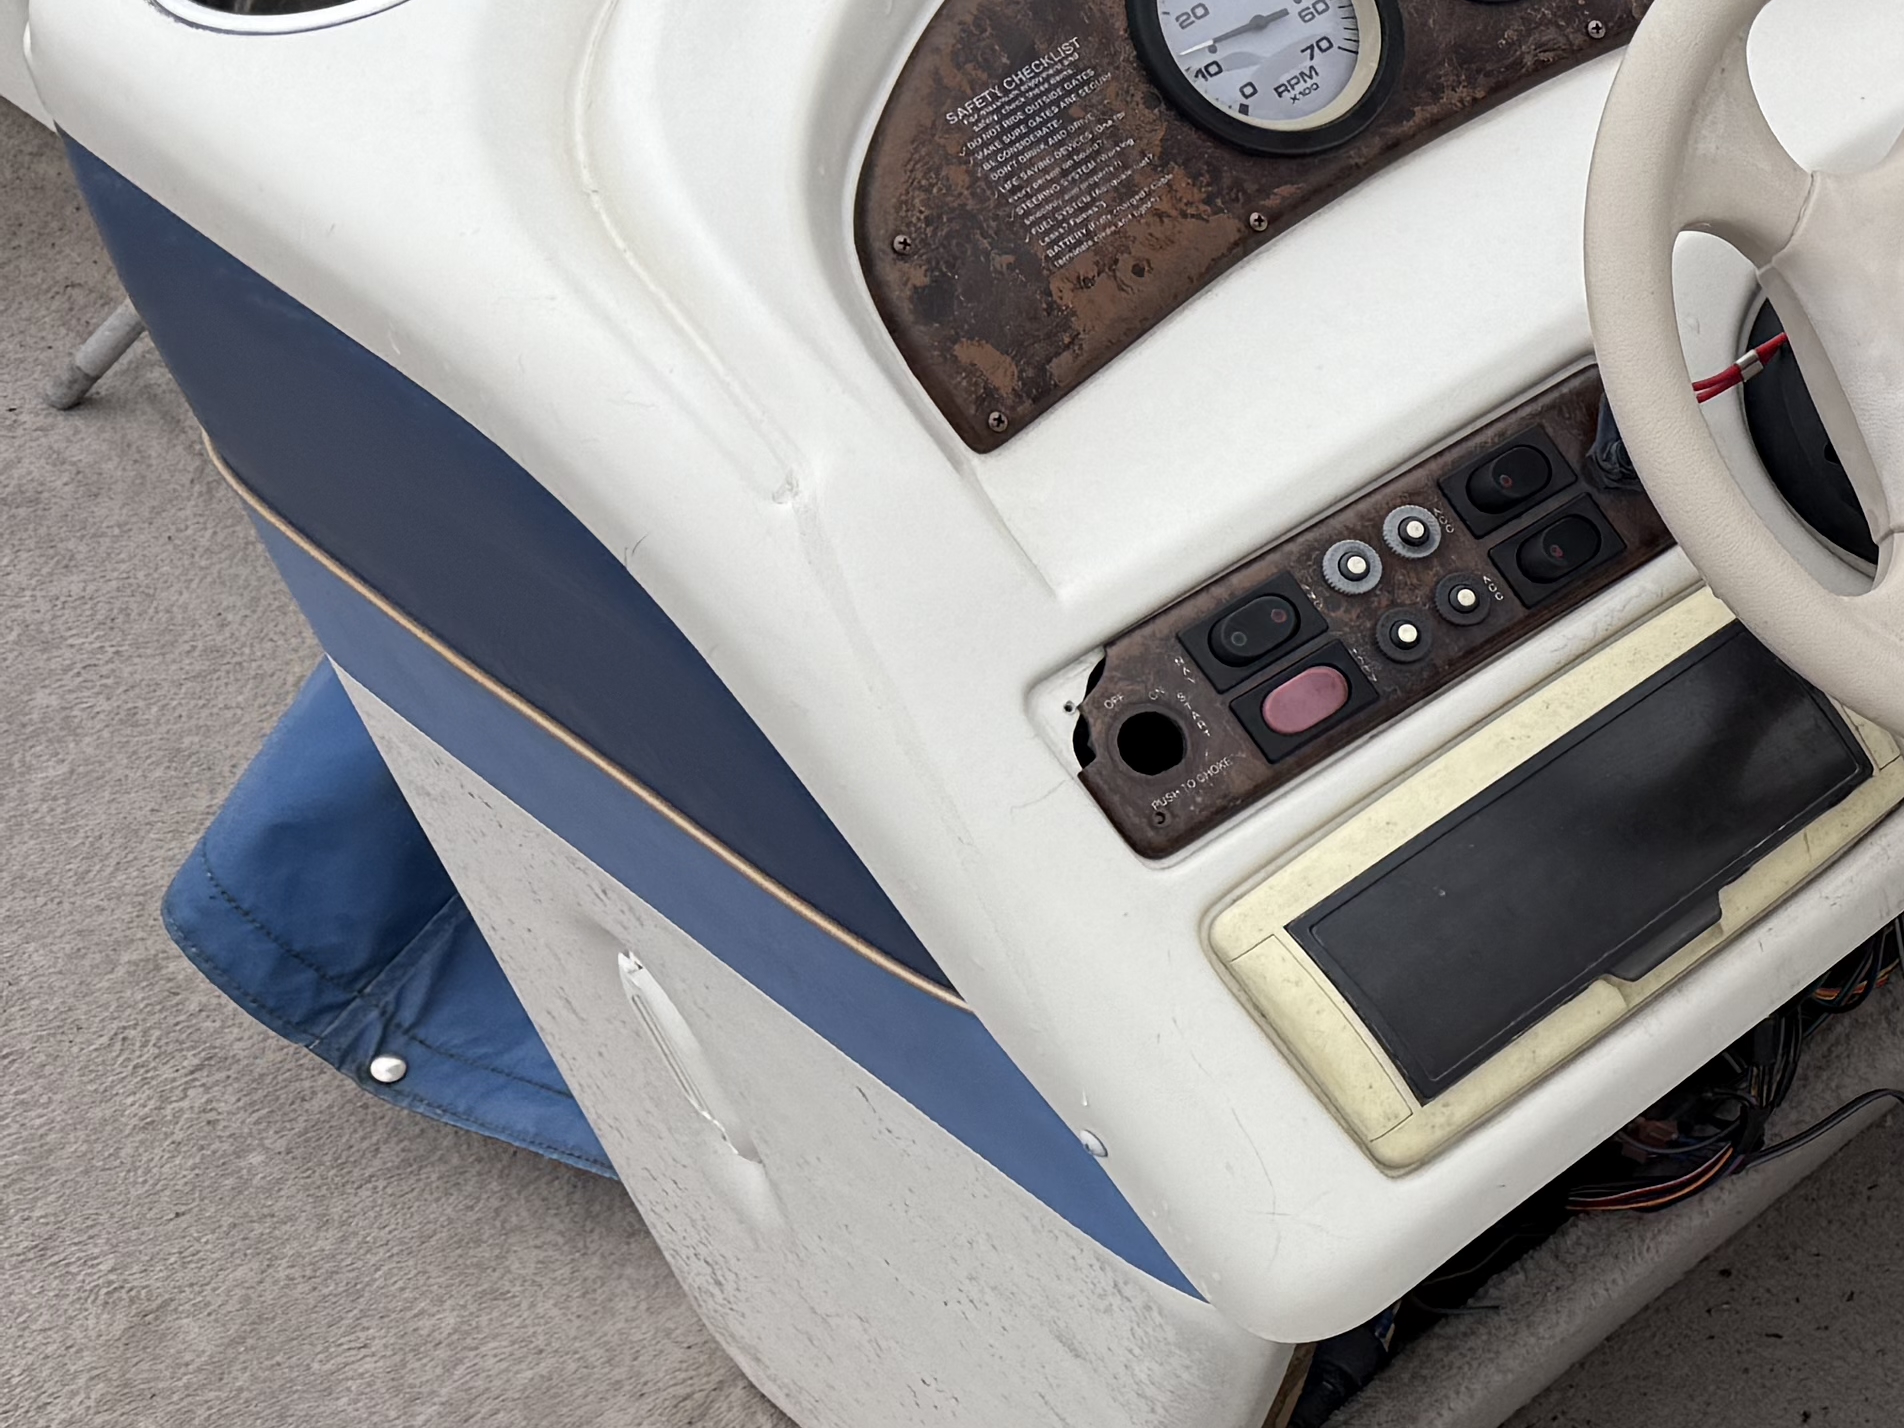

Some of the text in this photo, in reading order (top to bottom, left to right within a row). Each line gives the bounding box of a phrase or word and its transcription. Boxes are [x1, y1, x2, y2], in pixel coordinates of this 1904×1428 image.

[1175, 2, 1210, 30] 20
[1300, 35, 1334, 61] 70
[945, 36, 1081, 125] SAFETY CHECKLIST
[1194, 60, 1223, 82] 10
[1273, 65, 1320, 99] RPM
[1239, 81, 1258, 100] 0
[966, 67, 1095, 150] DO NOT RIDE OUTSIDE GATES
[1001, 123, 1027, 144] SURE
[1027, 104, 1059, 128] GATES
[1103, 692, 1126, 710] OFF
[1176, 692, 1212, 737] START
[1151, 788, 1181, 811] PUSH
[1196, 756, 1234, 785] CHOKE
